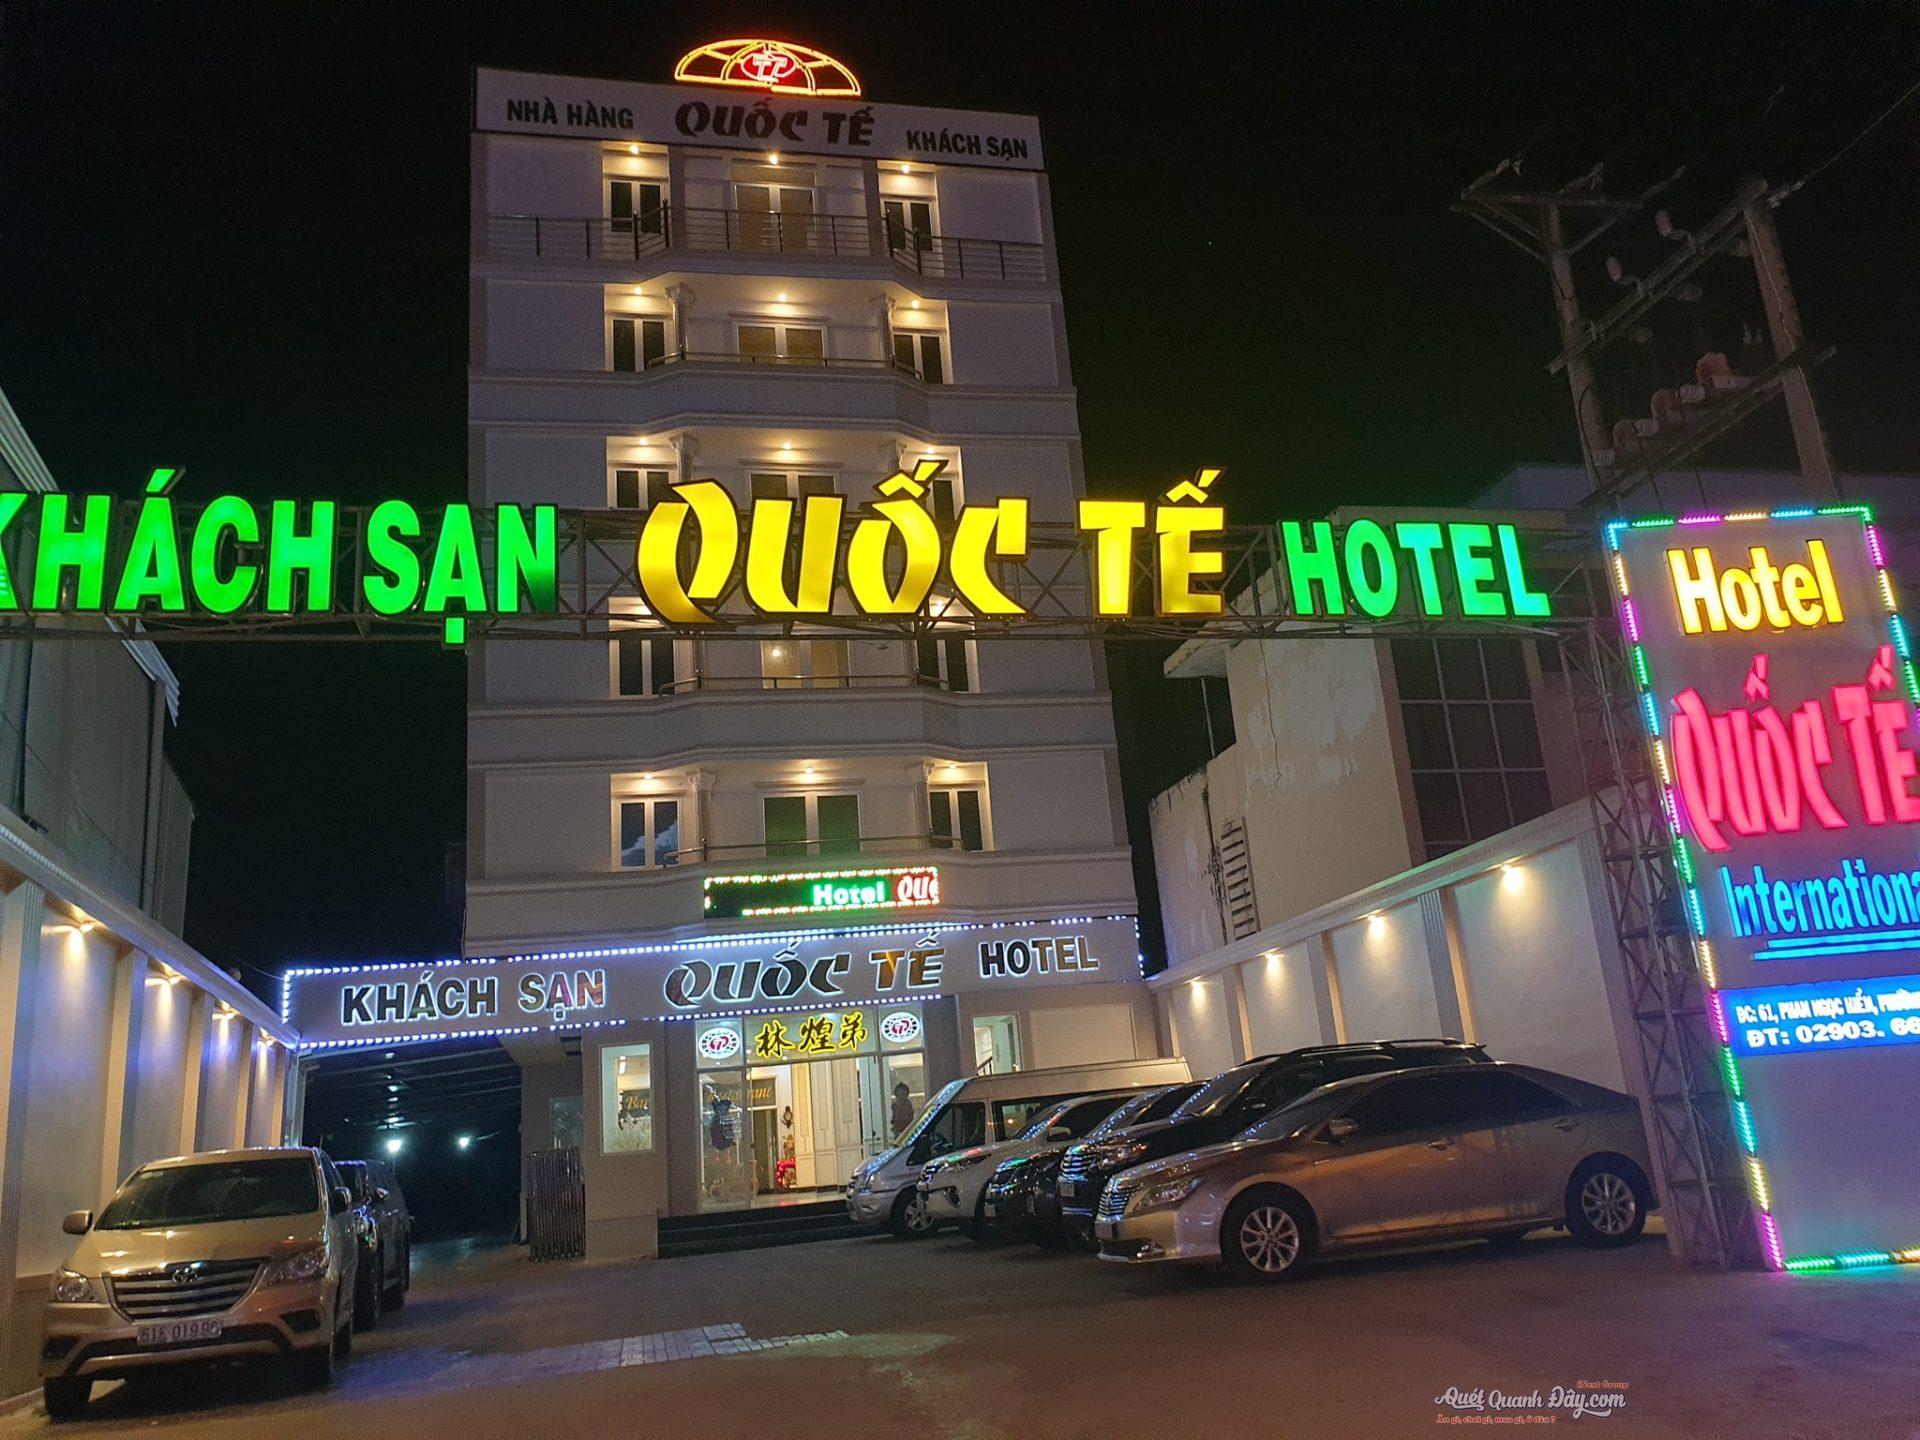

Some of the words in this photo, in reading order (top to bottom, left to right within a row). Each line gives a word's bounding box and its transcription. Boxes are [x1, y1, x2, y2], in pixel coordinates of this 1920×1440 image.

[507, 96, 557, 125] NHÀ
[567, 99, 634, 129] HÀNG
[823, 106, 875, 147] TẾ
[906, 128, 981, 155] KHÁCH
[986, 135, 1028, 161] SẠN
[637, 460, 1028, 625] QUỐC
[1079, 468, 1225, 616] TẾ
[1282, 518, 1551, 618] HOTEL
[363, 500, 558, 645] SẠN
[1666, 539, 1845, 635] Hotel
[1831, 644, 1920, 826] TẾ
[813, 881, 886, 906] Hotel
[868, 930, 945, 992] TẾ
[979, 935, 1100, 978] HOTEL
[341, 970, 498, 1026] KHÁCH
[518, 969, 606, 1022] SẠN
[1747, 1027, 1790, 1048] ĐT:
[1795, 1019, 1886, 1044] 02903.
